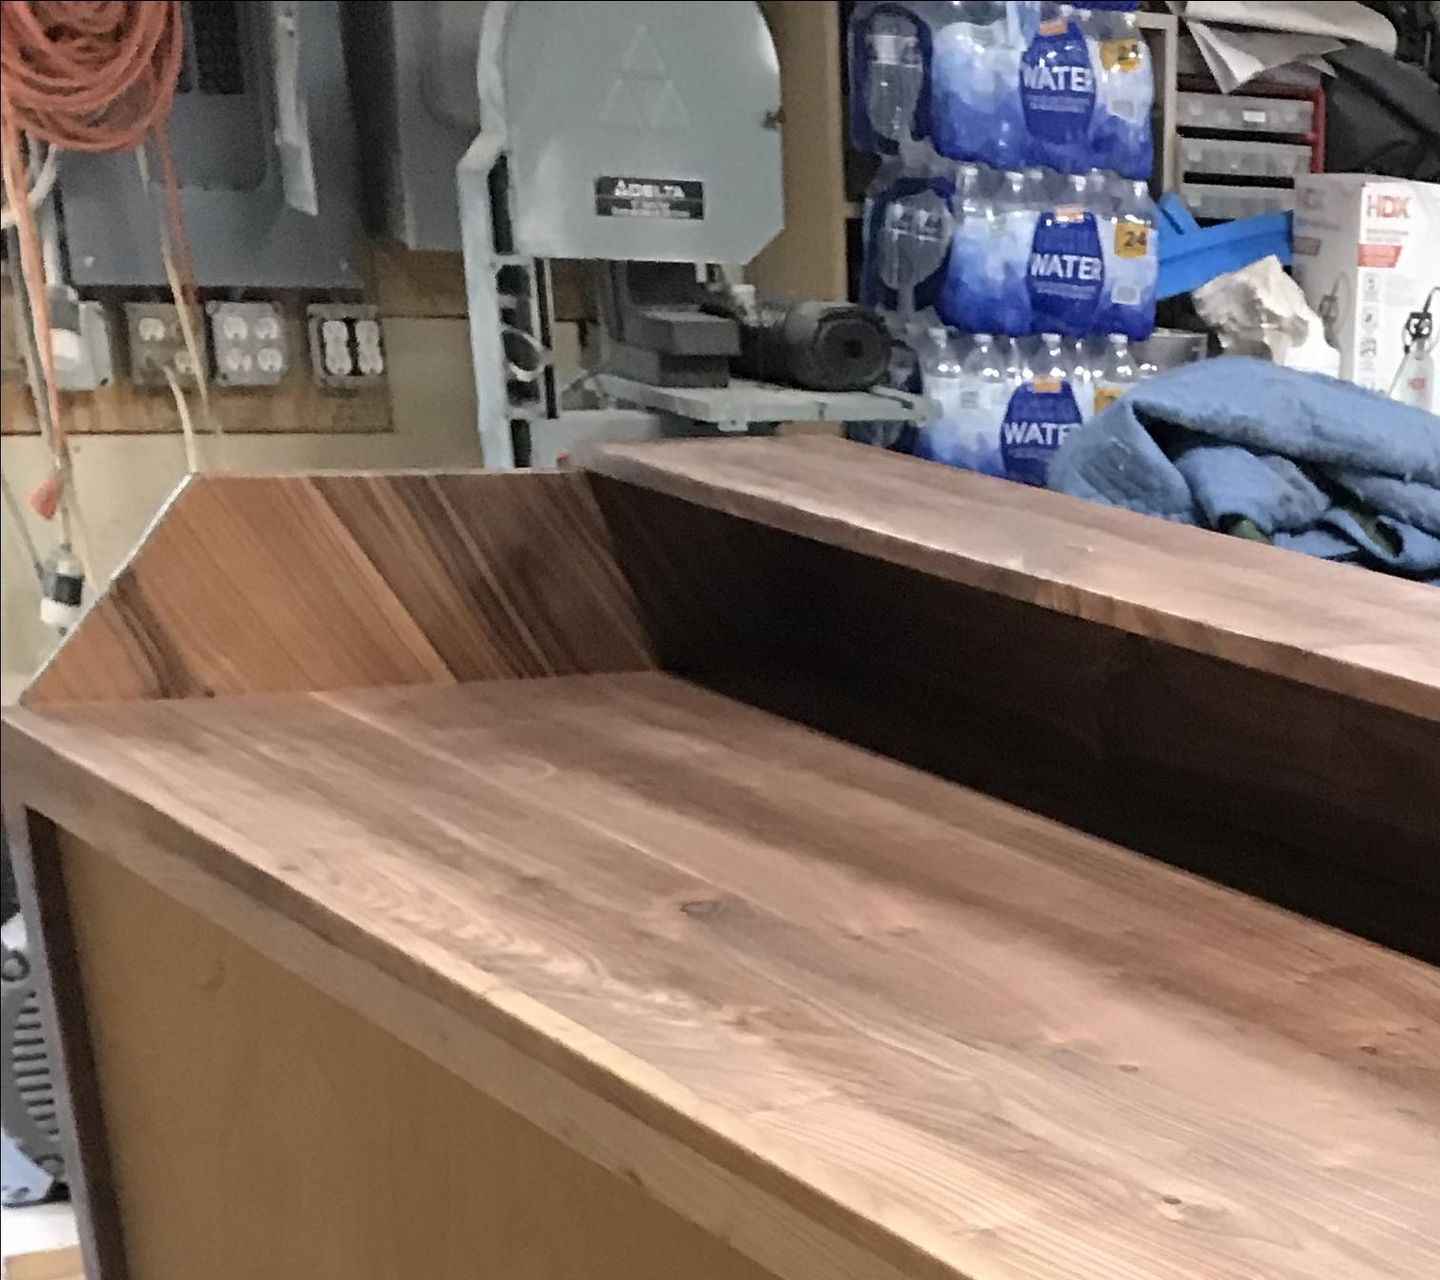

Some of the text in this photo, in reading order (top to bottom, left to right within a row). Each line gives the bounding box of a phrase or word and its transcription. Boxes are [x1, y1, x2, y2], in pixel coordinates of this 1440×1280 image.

[1366, 194, 1412, 219] HDX
[1123, 230, 1147, 248] 24
[1003, 421, 1080, 446] WATE
